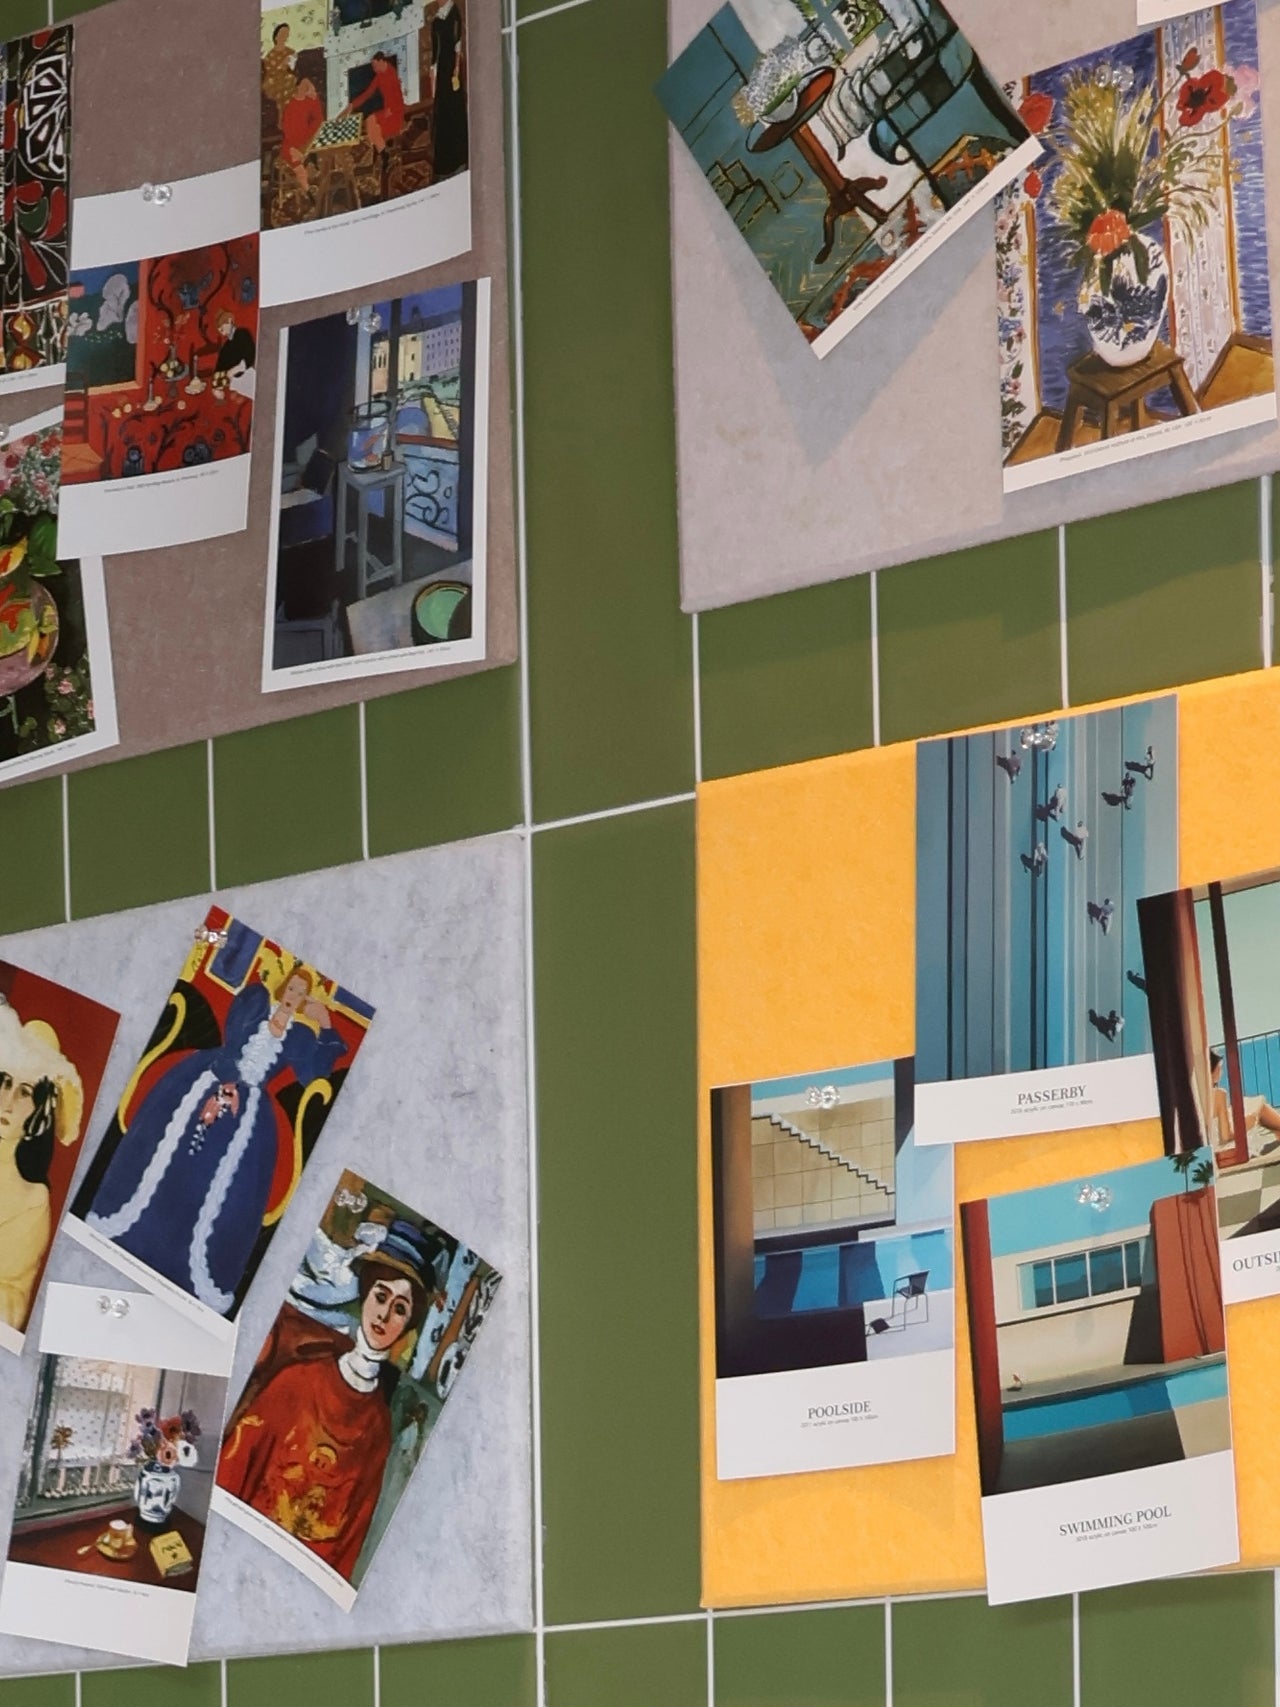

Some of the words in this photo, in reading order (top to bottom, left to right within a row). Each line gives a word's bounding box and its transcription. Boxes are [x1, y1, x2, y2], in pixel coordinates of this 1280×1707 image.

[1017, 1085, 1087, 1105] PASSERBY
[1232, 1250, 1280, 1272] OUTSI
[808, 1400, 872, 1419] POOLSIDE
[1059, 1512, 1133, 1536] SWIMMING
[1136, 1505, 1172, 1523] POOL
